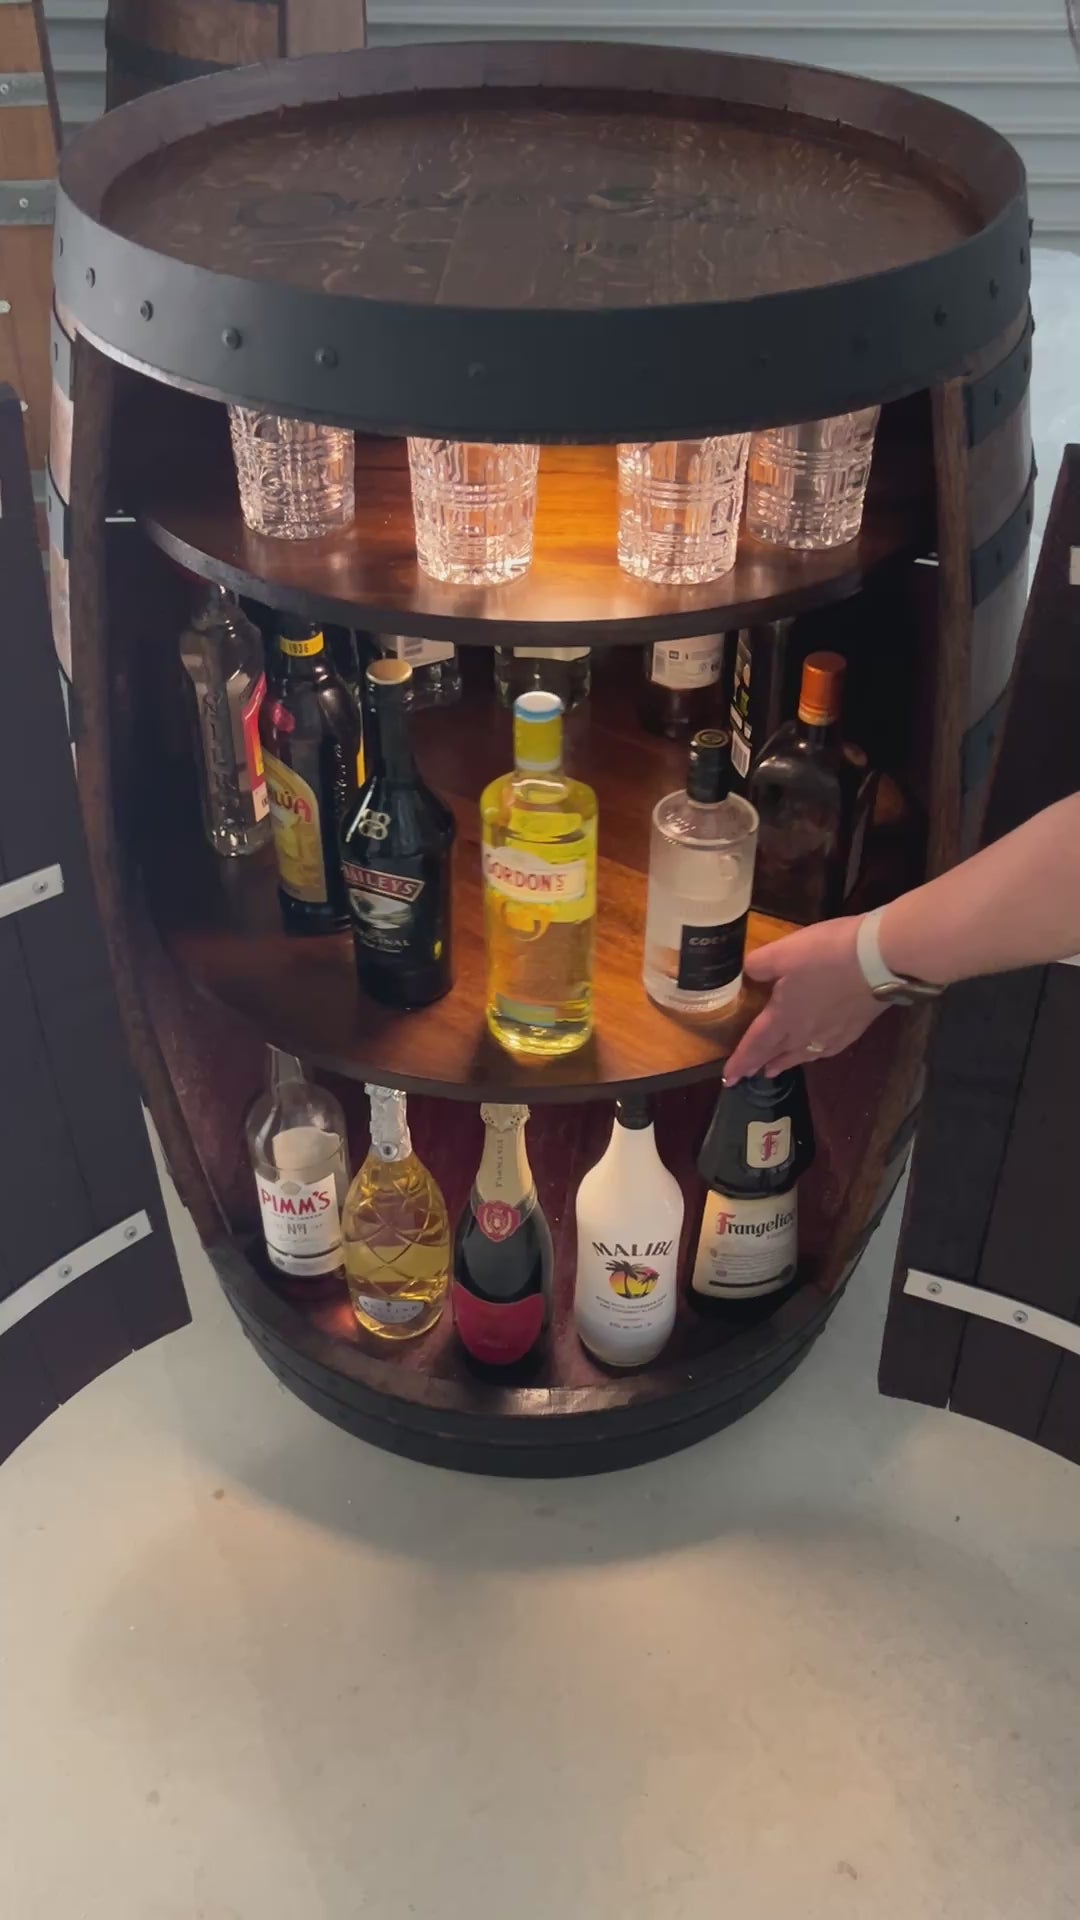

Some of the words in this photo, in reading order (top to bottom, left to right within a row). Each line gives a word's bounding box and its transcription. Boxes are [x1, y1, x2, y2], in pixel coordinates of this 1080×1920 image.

[487, 861, 566, 892] GORDON'S
[761, 1129, 782, 1163] F
[261, 1188, 331, 1216] PIMM'S
[591, 1240, 674, 1257] MALIBU
